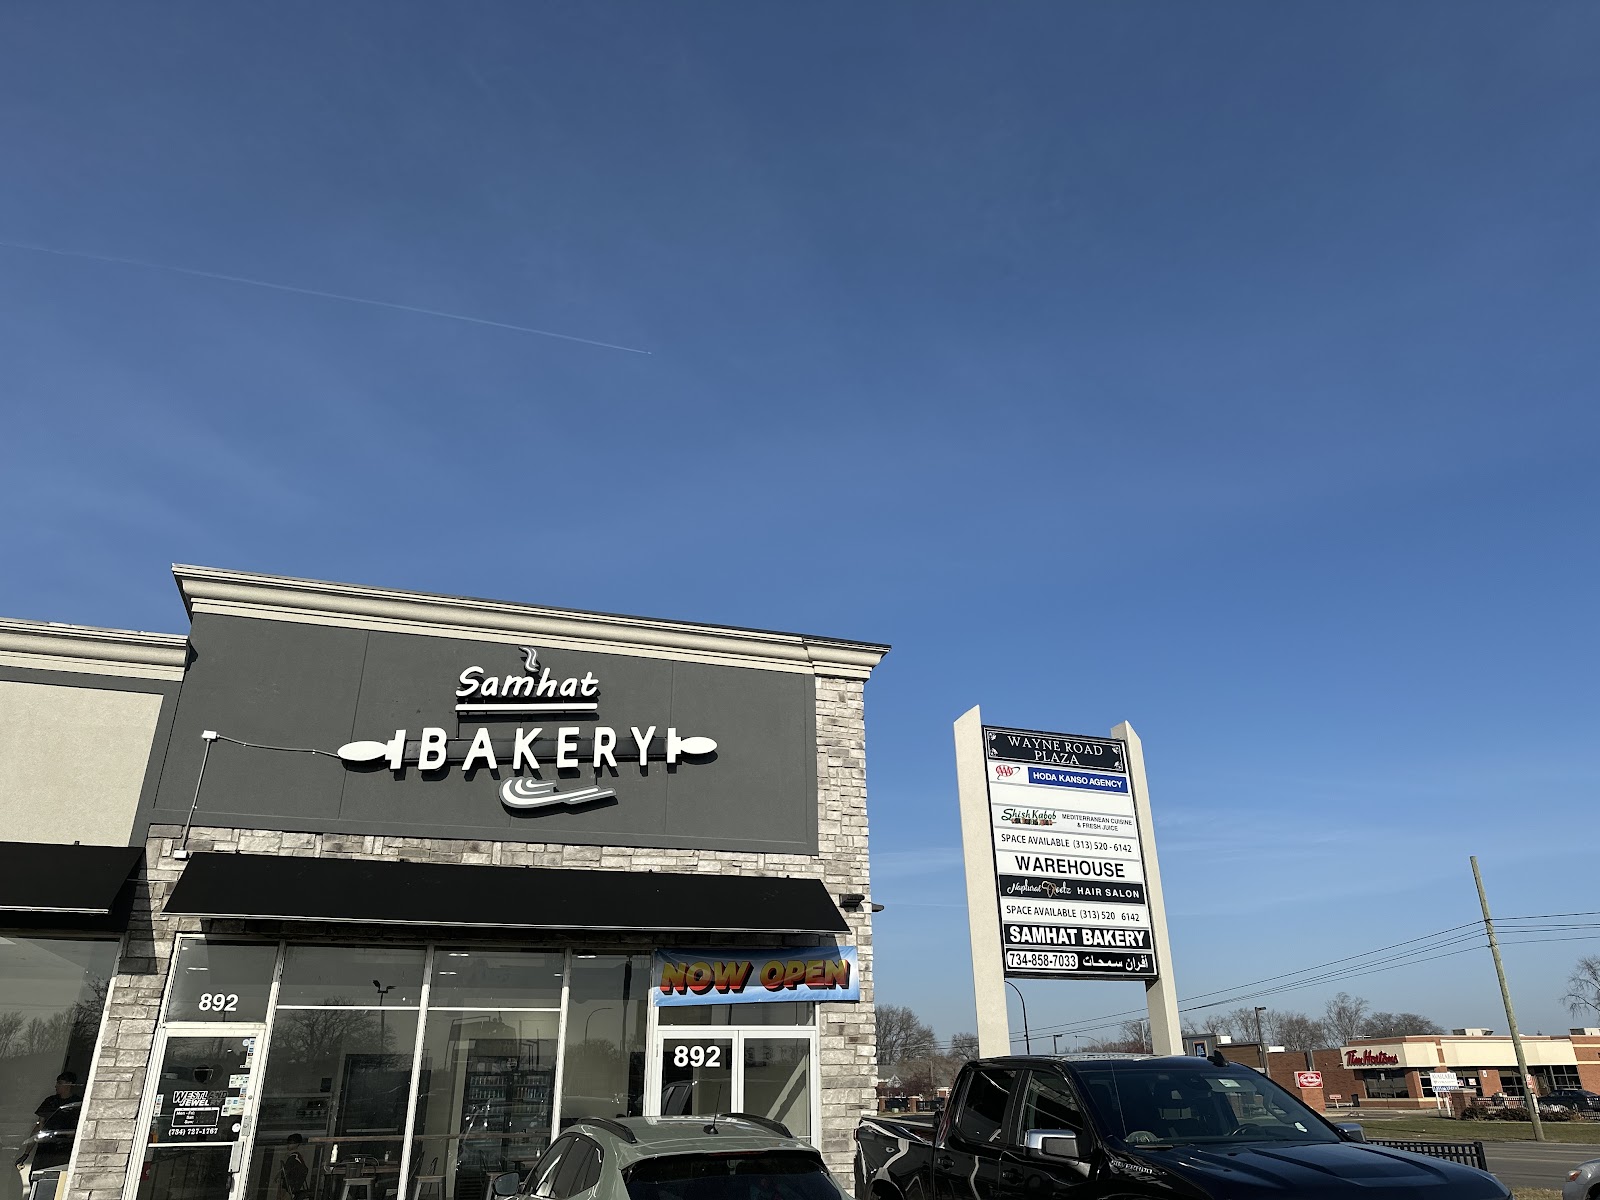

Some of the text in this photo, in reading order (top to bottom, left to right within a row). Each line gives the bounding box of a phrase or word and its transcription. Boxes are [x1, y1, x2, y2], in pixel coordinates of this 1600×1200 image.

[456, 666, 599, 698] Samhat
[418, 726, 656, 771] BAKERY
[1007, 735, 1103, 757] WAYNE ROAD
[1034, 751, 1079, 765] PLAZA
[1033, 772, 1122, 788] HODA KANSO AGENCY
[1001, 808, 1057, 821] Shish Kabob
[1062, 813, 1132, 826] MEDITERRANEAN CUISINE
[1001, 833, 1026, 844] SPACE
[1028, 835, 1070, 848] AVAILABLE
[1073, 839, 1093, 850] (313)
[1094, 841, 1108, 851] 520
[1113, 843, 1132, 853] 6142
[1015, 855, 1125, 878] WAREHOUSE
[1077, 887, 1102, 897] HAIR
[1105, 888, 1140, 898] SALON
[1006, 905, 1140, 922] SPACE AVAILABLE (313) 520 6142
[1009, 926, 1145, 947] SAMHAT BAKERY
[1009, 953, 1077, 968] 734-858-7033
[659, 959, 851, 995] NOW OPEN
[198, 993, 239, 1012] 892
[673, 1045, 721, 1067] 892
[1344, 1049, 1399, 1067] Tim Hortons
[173, 1090, 229, 1103] WESTLAND
